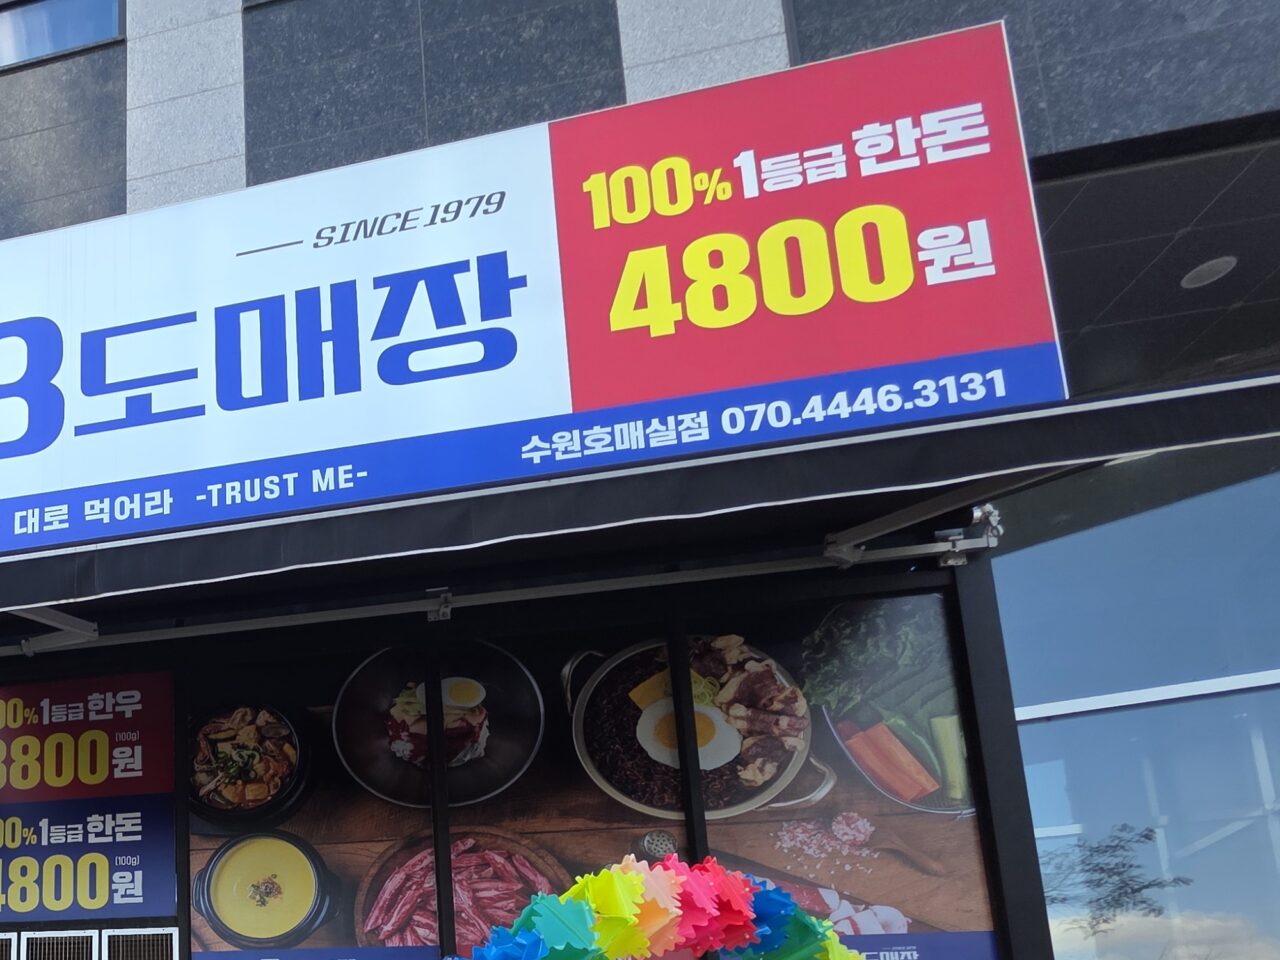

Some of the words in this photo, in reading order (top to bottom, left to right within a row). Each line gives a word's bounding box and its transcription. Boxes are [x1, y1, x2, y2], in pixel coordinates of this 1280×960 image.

[582, 156, 733, 230] 100%
[733, 144, 847, 199] 1등급
[852, 102, 992, 177] 한돈
[609, 204, 996, 338] 4800원
[520, 412, 711, 465] 수원호매실점
[721, 369, 1007, 435] 070.4446.3131
[13, 505, 70, 534] 대로
[84, 489, 173, 524] 먹어라
[196, 472, 298, 509] -TRUST
[312, 464, 369, 492] ME-
[40, 698, 84, 725] 1등급
[87, 690, 143, 721] 한우
[39, 818, 84, 846] 1등급
[87, 812, 143, 844] 한돈
